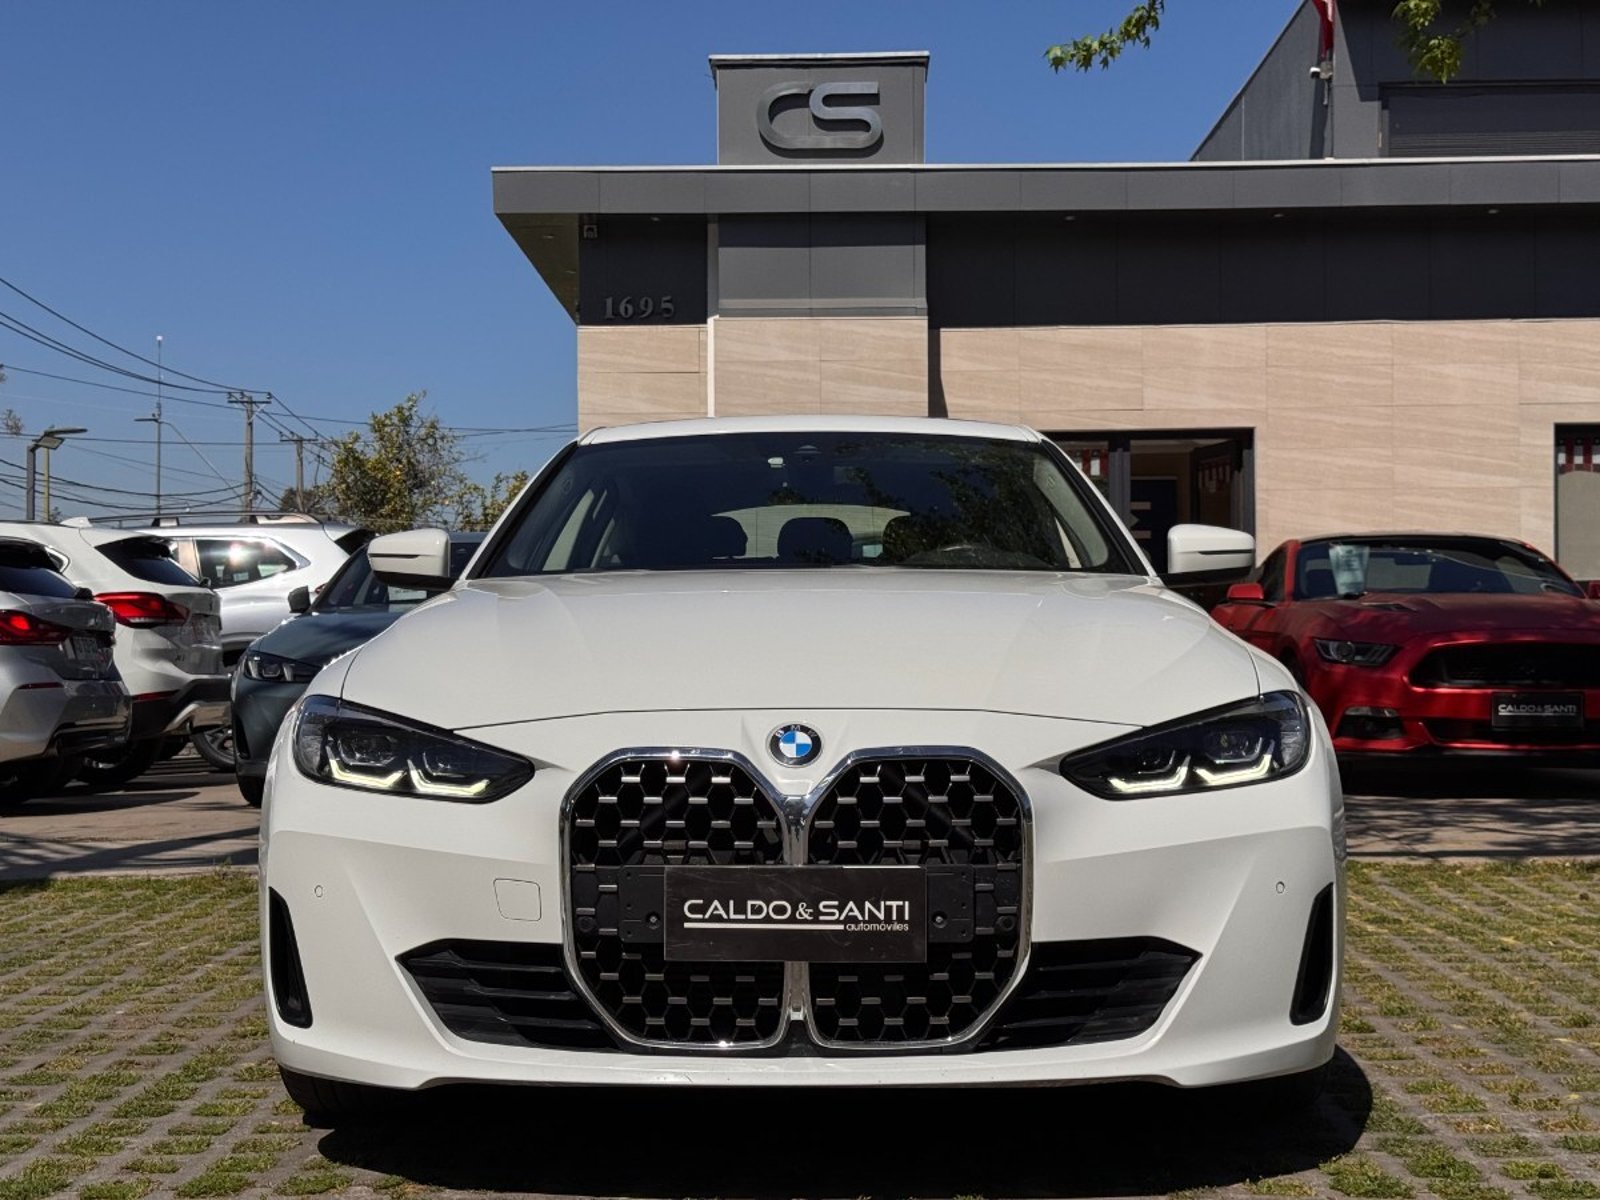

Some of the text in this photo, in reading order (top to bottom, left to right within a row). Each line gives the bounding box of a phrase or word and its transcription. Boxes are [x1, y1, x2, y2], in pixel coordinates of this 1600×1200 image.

[756, 81, 882, 149] CS
[605, 296, 674, 318] 1695
[846, 921, 910, 932] automóviles
